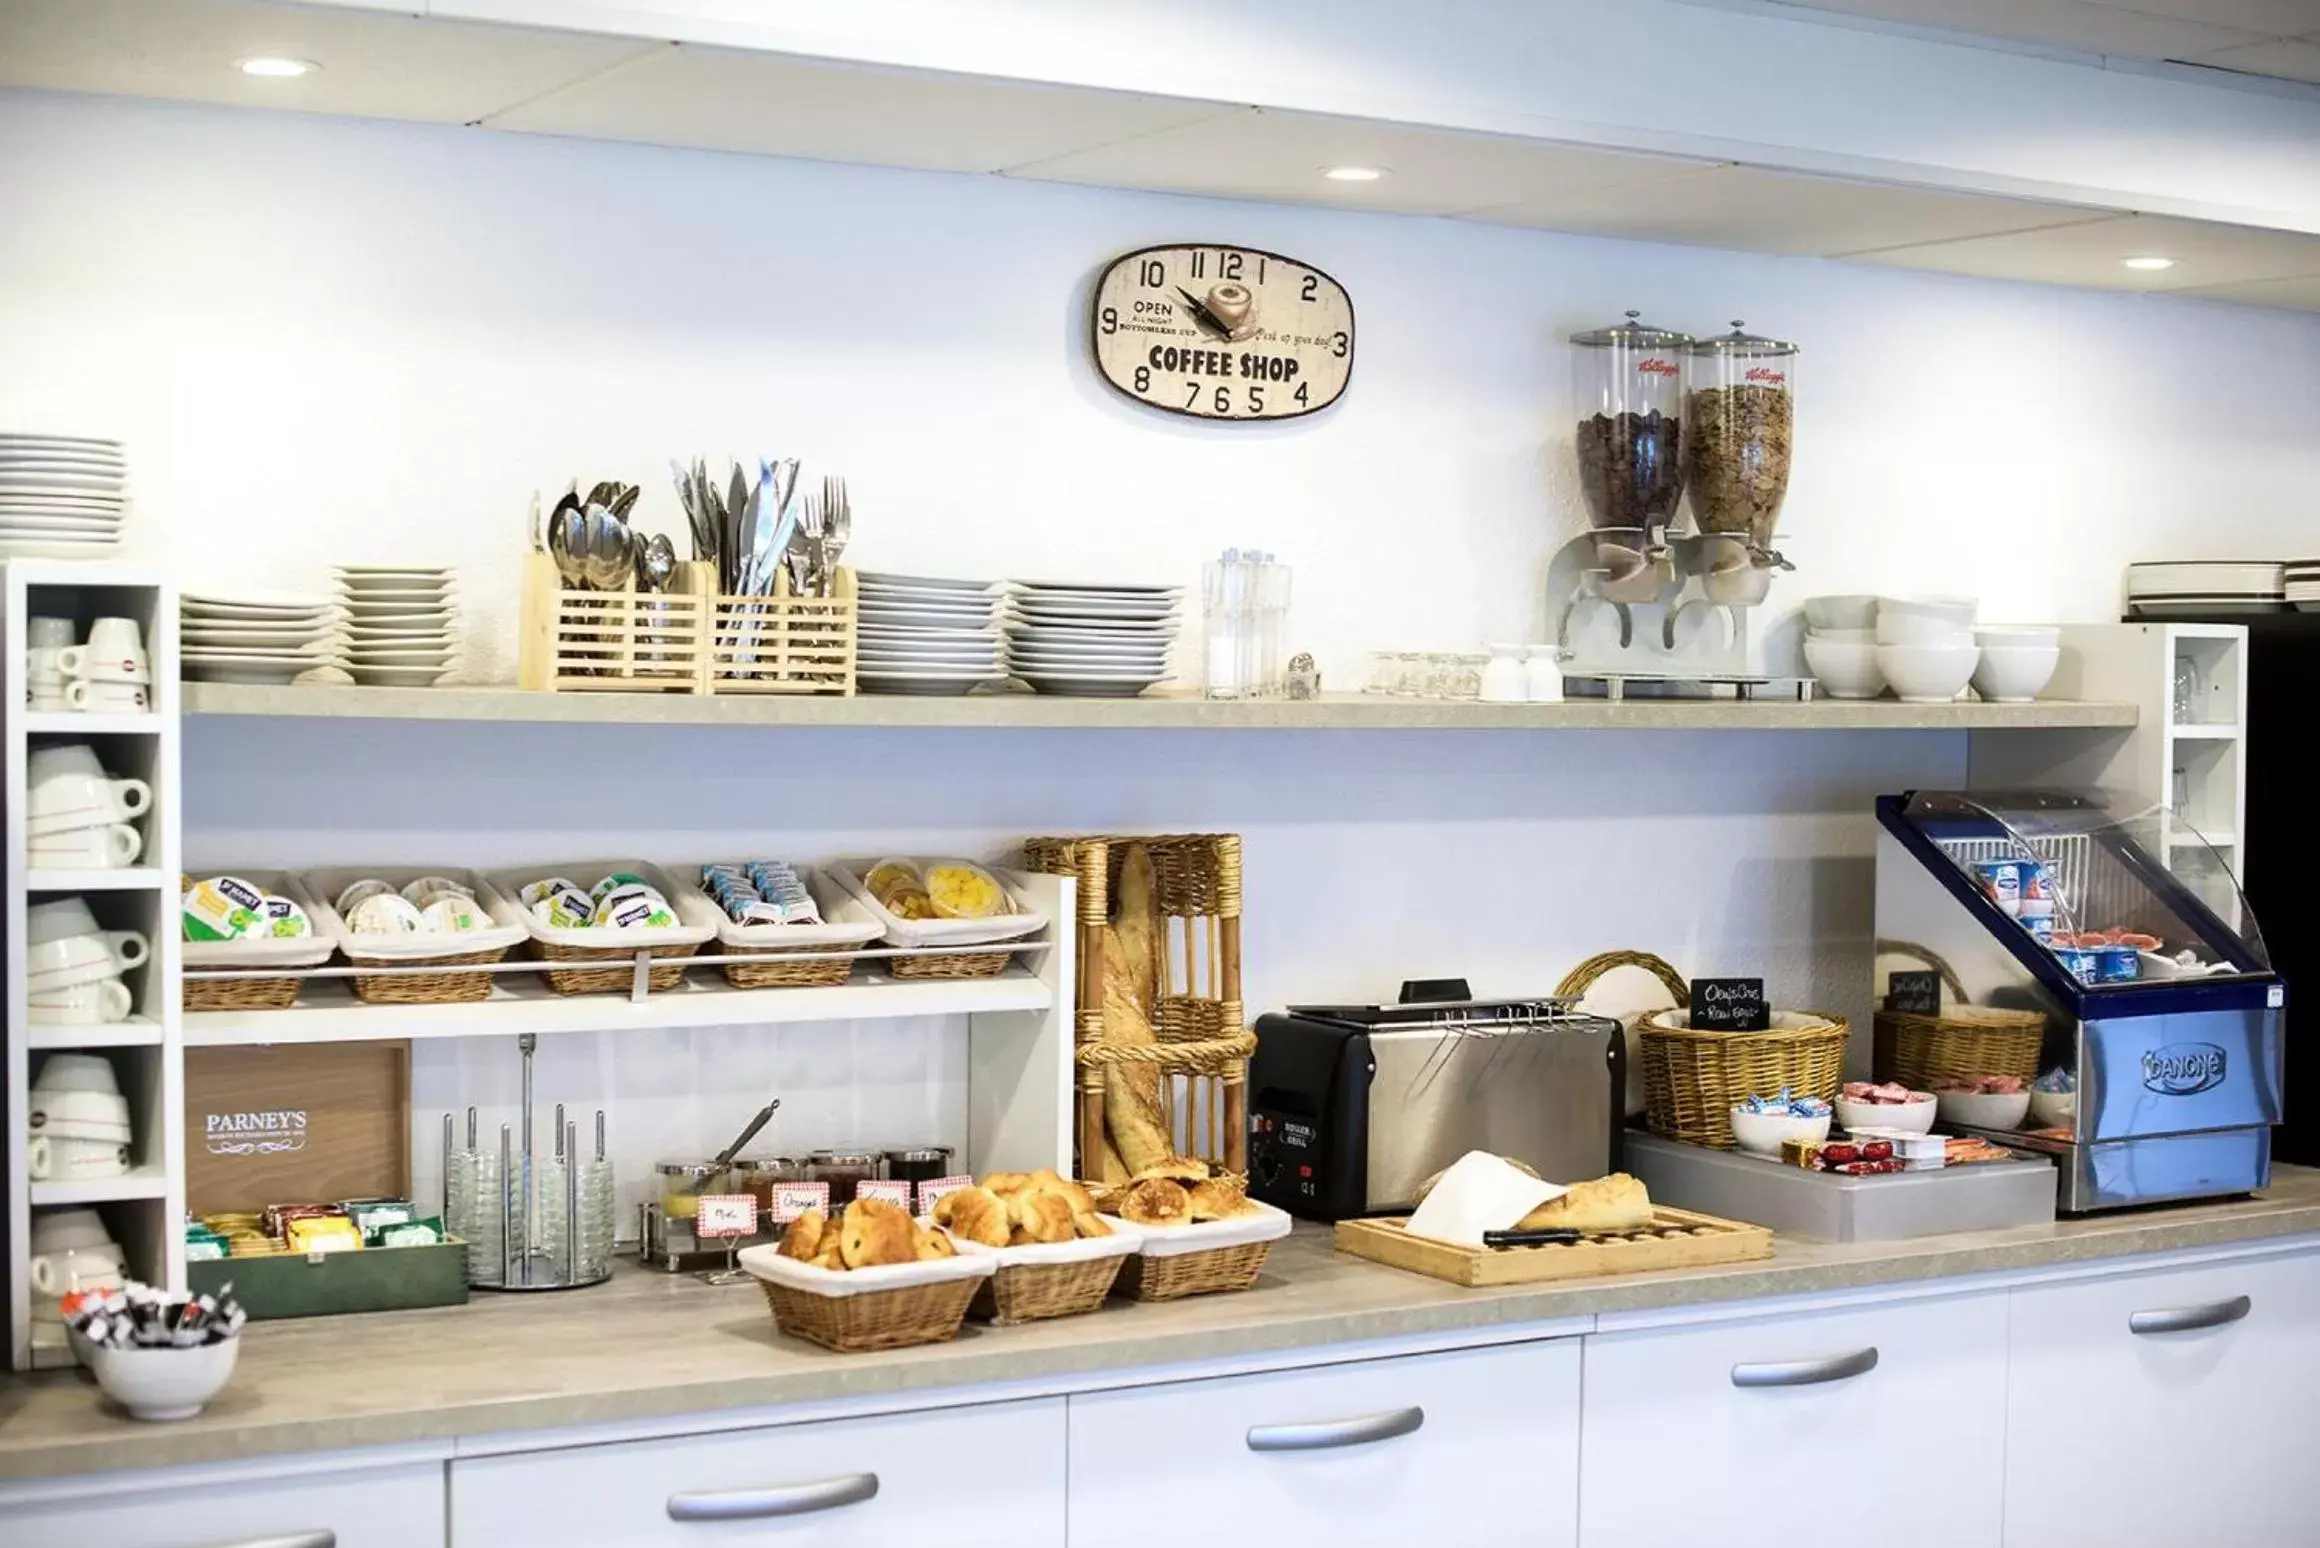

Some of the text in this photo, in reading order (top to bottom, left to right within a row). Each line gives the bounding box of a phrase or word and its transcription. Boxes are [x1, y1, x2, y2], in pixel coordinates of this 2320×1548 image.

[1140, 260, 1164, 287] 10
[1192, 252, 1204, 278] 11
[1219, 253, 1242, 280] 12
[1259, 259, 1264, 285] 1
[1301, 275, 1317, 302] 2
[1102, 308, 1117, 335] 9
[1135, 301, 1172, 316] OPEN
[1332, 332, 1347, 357] 3
[1149, 345, 1299, 382] COFFEE SHOP
[1135, 366, 1149, 392] 8
[1186, 382, 1201, 408] 7
[1215, 387, 1230, 413] 6
[1248, 387, 1264, 413] 5
[1294, 382, 1308, 407] 4
[2151, 1051, 2221, 1081] DANONE
[205, 1111, 307, 1132] PARNEY'S
